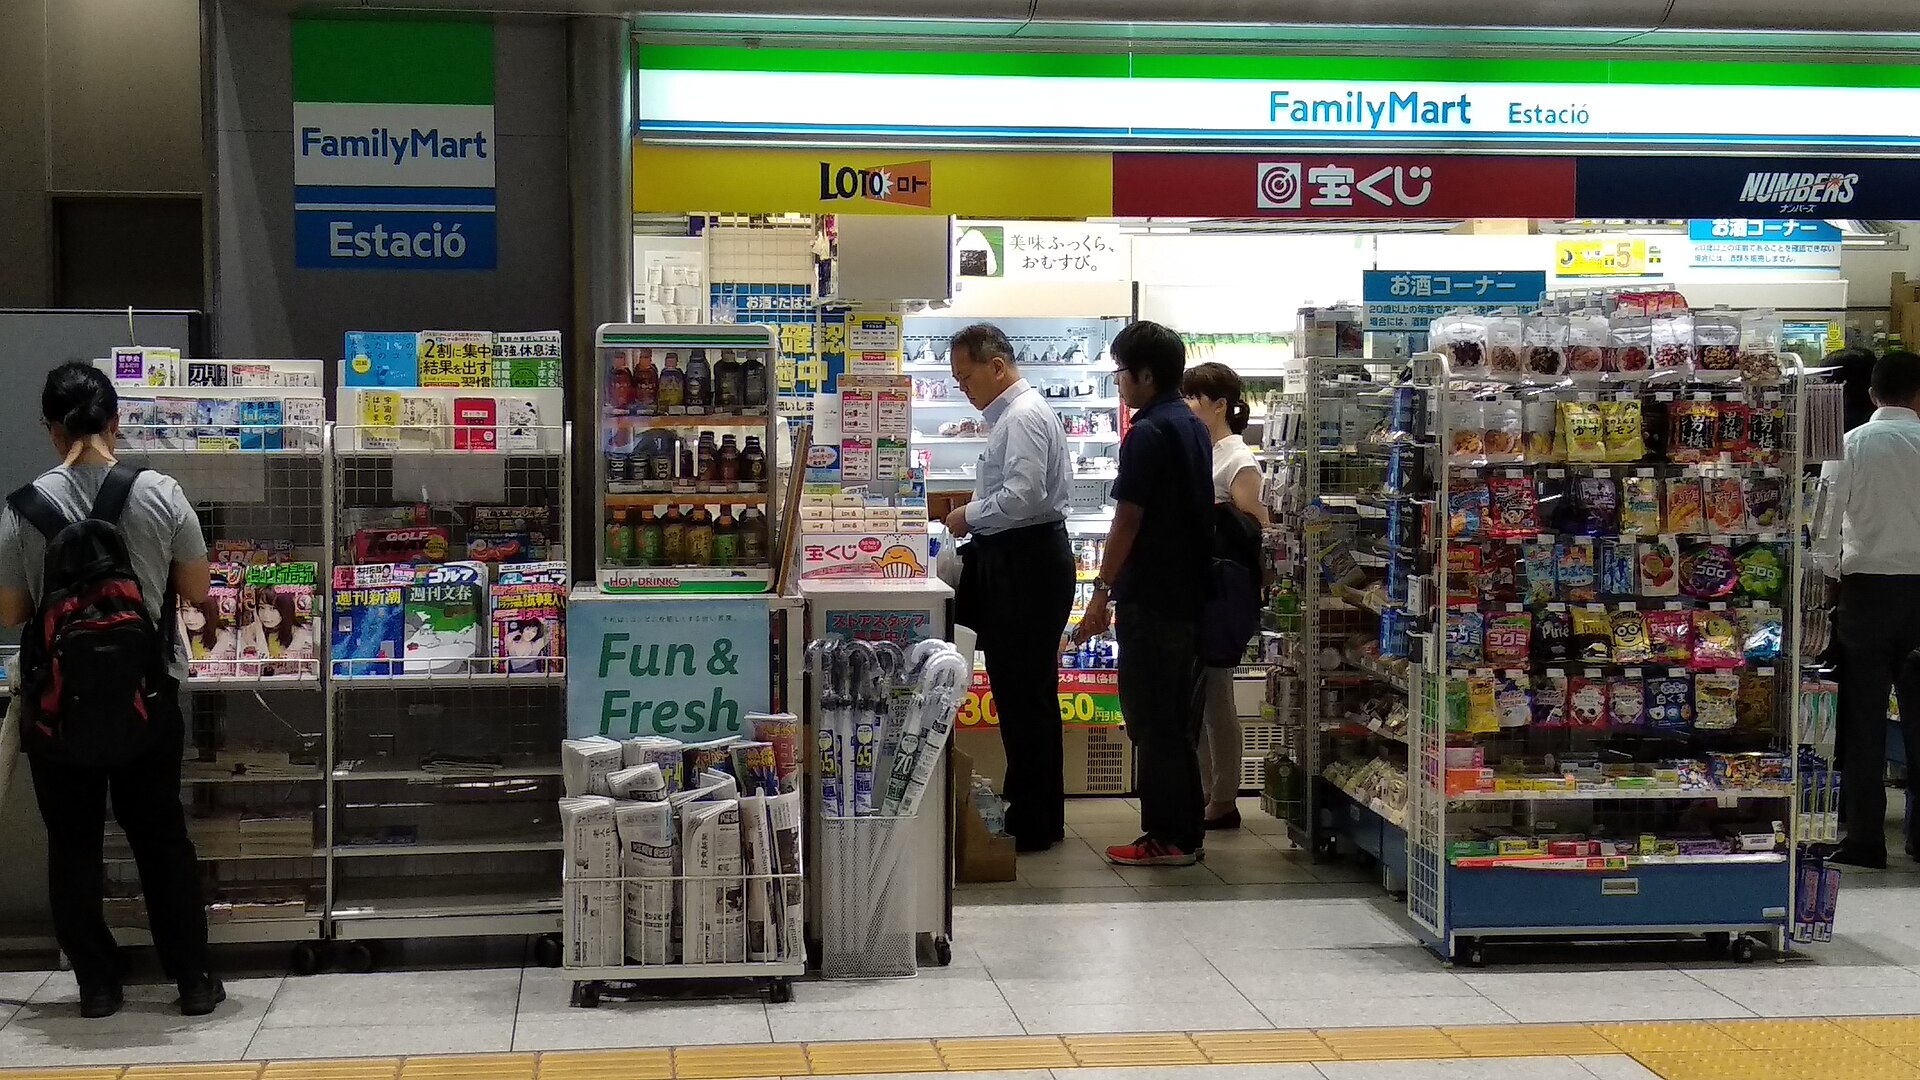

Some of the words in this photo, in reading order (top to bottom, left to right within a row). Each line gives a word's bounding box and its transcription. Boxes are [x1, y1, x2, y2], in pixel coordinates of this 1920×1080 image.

[1270, 90, 1472, 130] FamilyMart
[1508, 102, 1590, 126] Estació
[301, 127, 487, 166] FamilyMart
[819, 162, 884, 200] LOTO
[897, 175, 928, 194] ロト
[1309, 164, 1433, 207] 宝くじ
[1739, 172, 1859, 204] NUMBERS
[1779, 203, 1817, 214] ナンバーズ
[1711, 218, 1818, 238] お酒コーナー
[328, 222, 467, 260] Estació
[1008, 234, 1115, 253] 美味ふっくら、
[1022, 253, 1098, 272] おむすび。
[1389, 274, 1517, 297] お酒コーナー
[424, 338, 491, 359] 2割に集中
[423, 360, 491, 375] 結果を出す
[386, 532, 430, 542] GOLF
[804, 544, 858, 561] 宝くじ
[609, 576, 635, 586] HOT
[638, 576, 680, 587] DRINKS
[335, 588, 402, 607] 週刊新潮
[409, 585, 473, 602] 週刊文春
[832, 612, 926, 629] ストアスタッフ
[1490, 633, 1527, 646] コグミ
[598, 632, 696, 678] Fun
[706, 638, 739, 676] &
[600, 687, 741, 735] Fresh
[1057, 692, 1094, 721] 50
